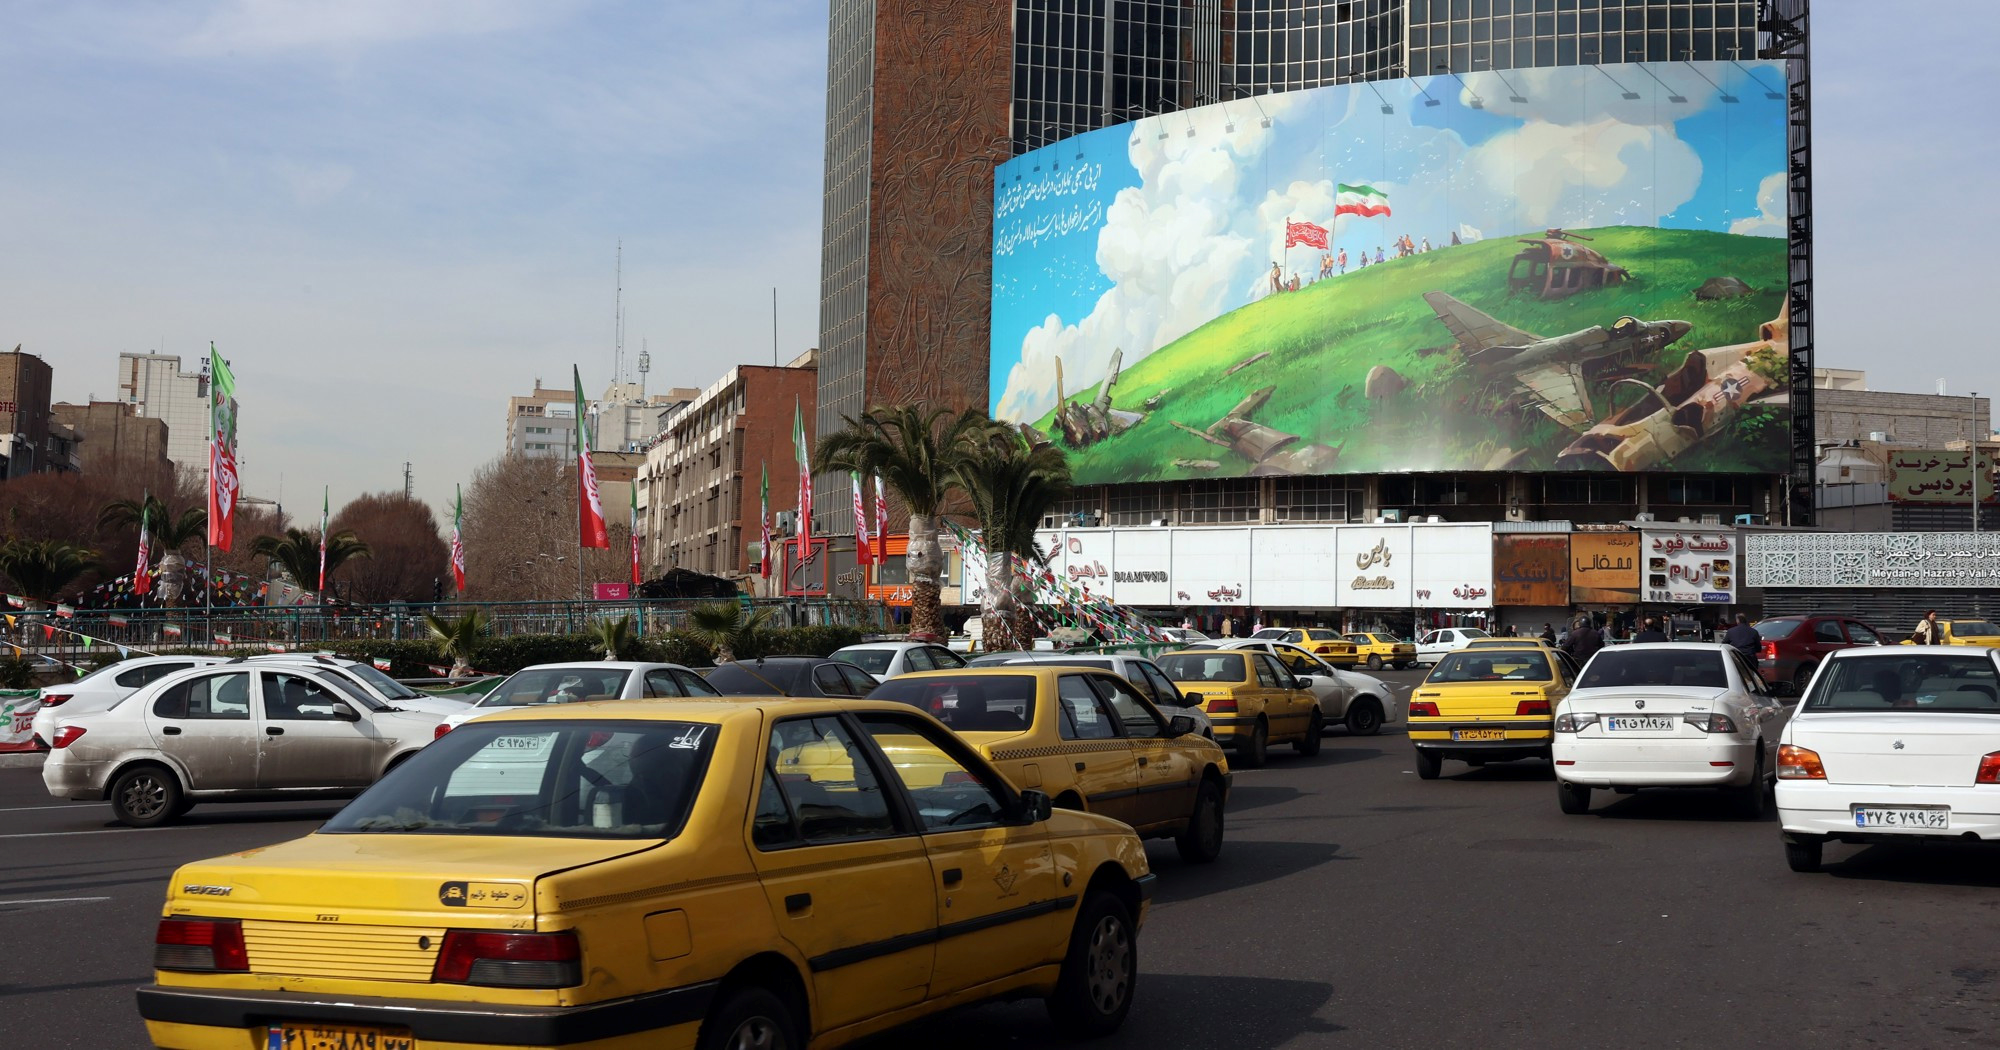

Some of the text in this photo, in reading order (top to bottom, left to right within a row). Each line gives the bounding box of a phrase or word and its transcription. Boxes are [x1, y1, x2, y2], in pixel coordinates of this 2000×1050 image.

[1895, 455, 1941, 472] خرید
[1908, 477, 1973, 496] پردیس
[1607, 539, 1634, 548] فروشگاه
[1652, 533, 1729, 554] فست فود
[1356, 536, 1392, 569] بالین
[1886, 549, 1910, 559] عصر
[1913, 548, 1931, 560] ولی
[1934, 548, 1972, 559] حضرت
[1669, 563, 1710, 584] آرام
[1872, 569, 1920, 579] Meydan-e
[1923, 569, 1965, 578] Hazrat-e
[1968, 569, 1987, 578] Vali
[1351, 576, 1394, 590] Balin
[1207, 583, 1242, 601] زیبایی
[1452, 584, 1486, 600] موزه
[1649, 591, 1671, 600] VIP
[183, 884, 233, 896] PEUGEOT
